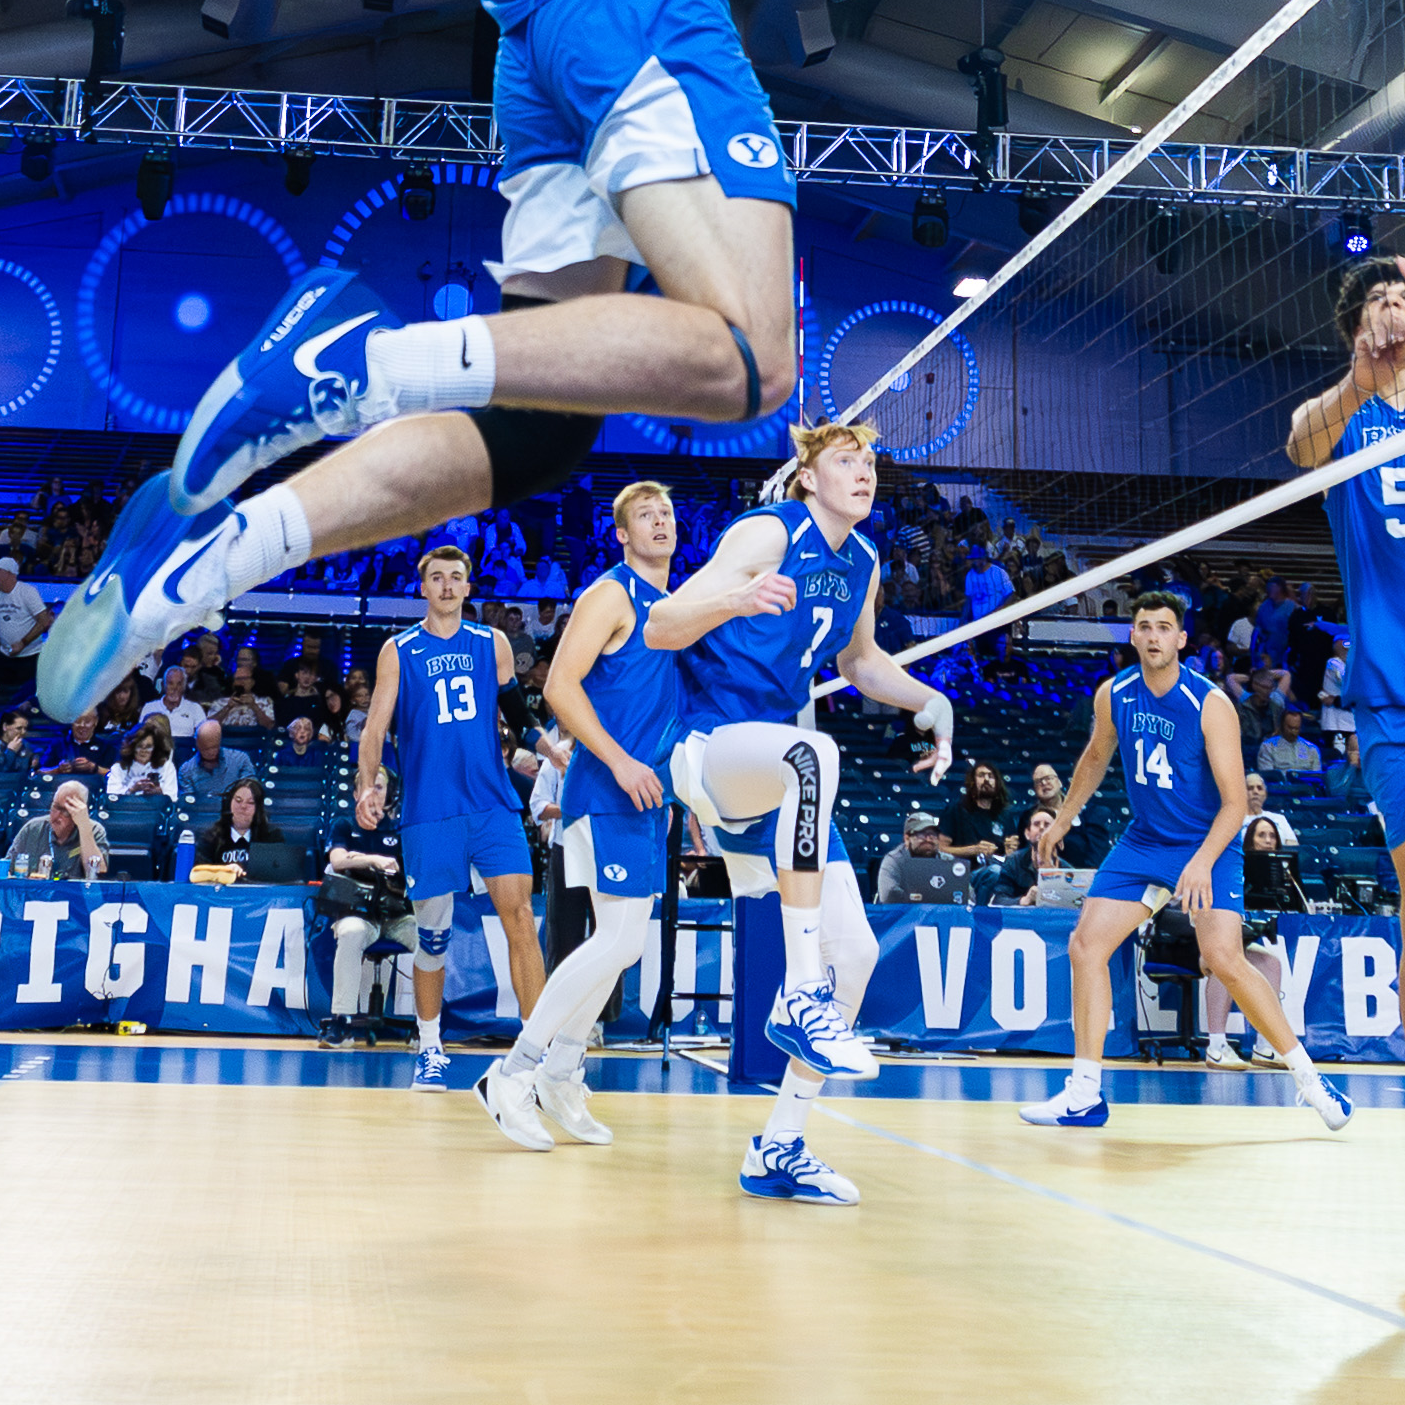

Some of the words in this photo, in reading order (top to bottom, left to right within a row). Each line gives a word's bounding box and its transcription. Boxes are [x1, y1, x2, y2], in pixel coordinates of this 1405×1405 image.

[804, 570, 852, 602] BYU
[800, 606, 834, 669] 7
[426, 653, 474, 678] BYU
[434, 675, 478, 725] 13
[1132, 712, 1176, 741] BYU
[787, 745, 817, 802] NIKE
[1135, 738, 1174, 789] 14
[798, 804, 816, 857] PRO
